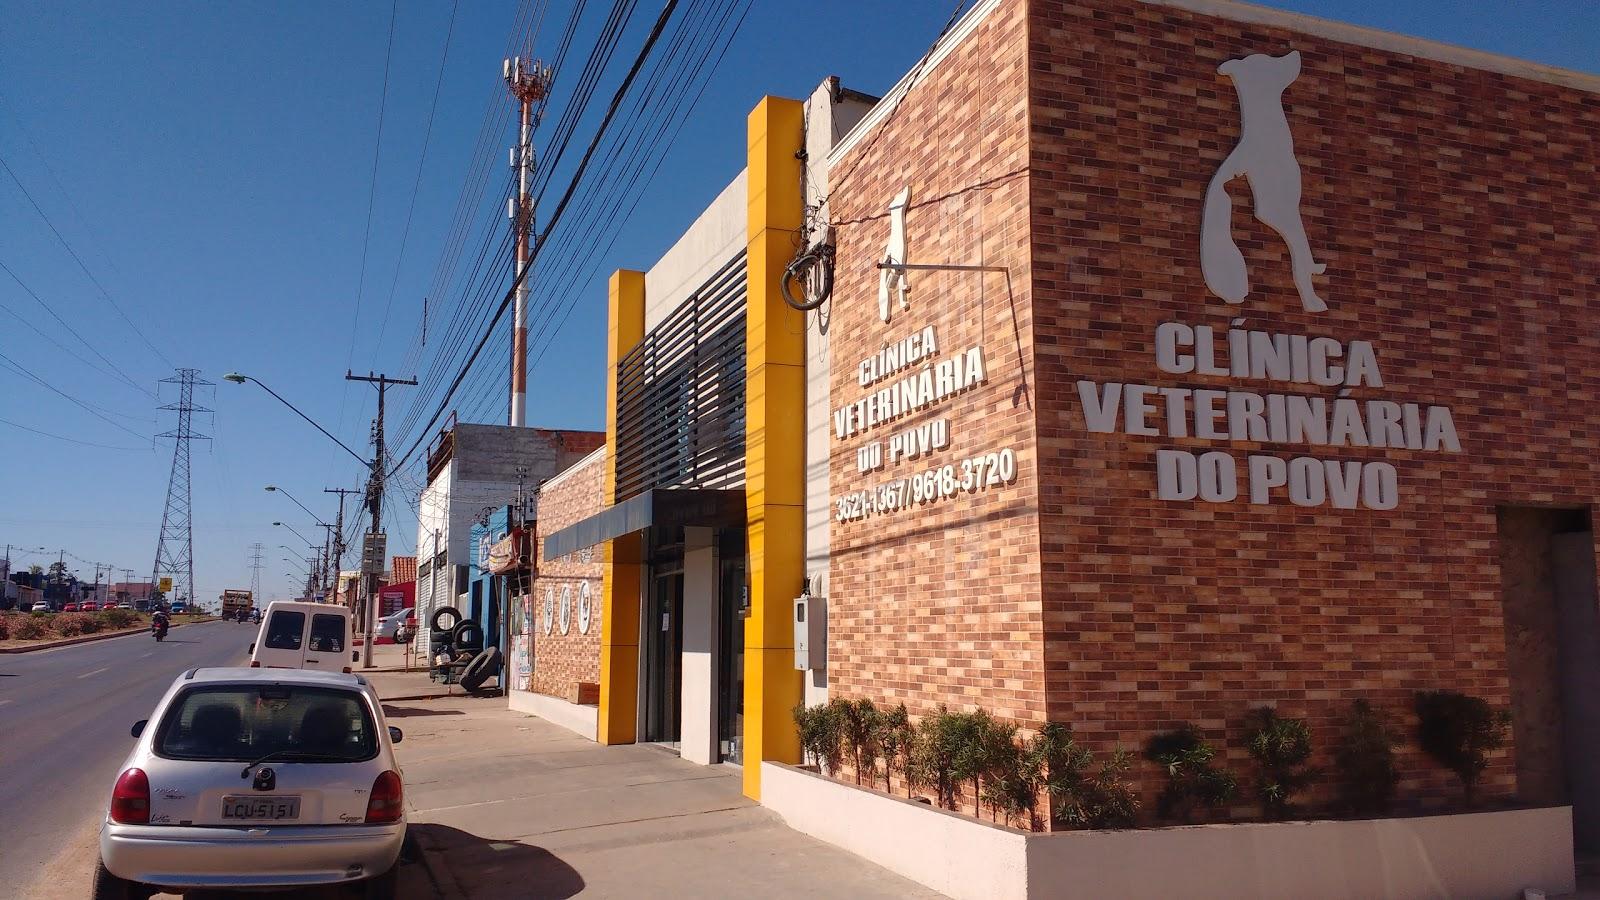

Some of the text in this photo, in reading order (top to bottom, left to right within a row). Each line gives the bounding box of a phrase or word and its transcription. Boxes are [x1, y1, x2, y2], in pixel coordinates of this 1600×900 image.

[859, 325, 939, 387] CLÍNICA
[1156, 318, 1383, 388] CLÍNICA
[834, 345, 986, 439] VETERINÁRIA
[1077, 380, 1462, 453] VETERINÁRIA
[857, 418, 949, 473] DO POVO
[1157, 449, 1399, 510] DO POVO
